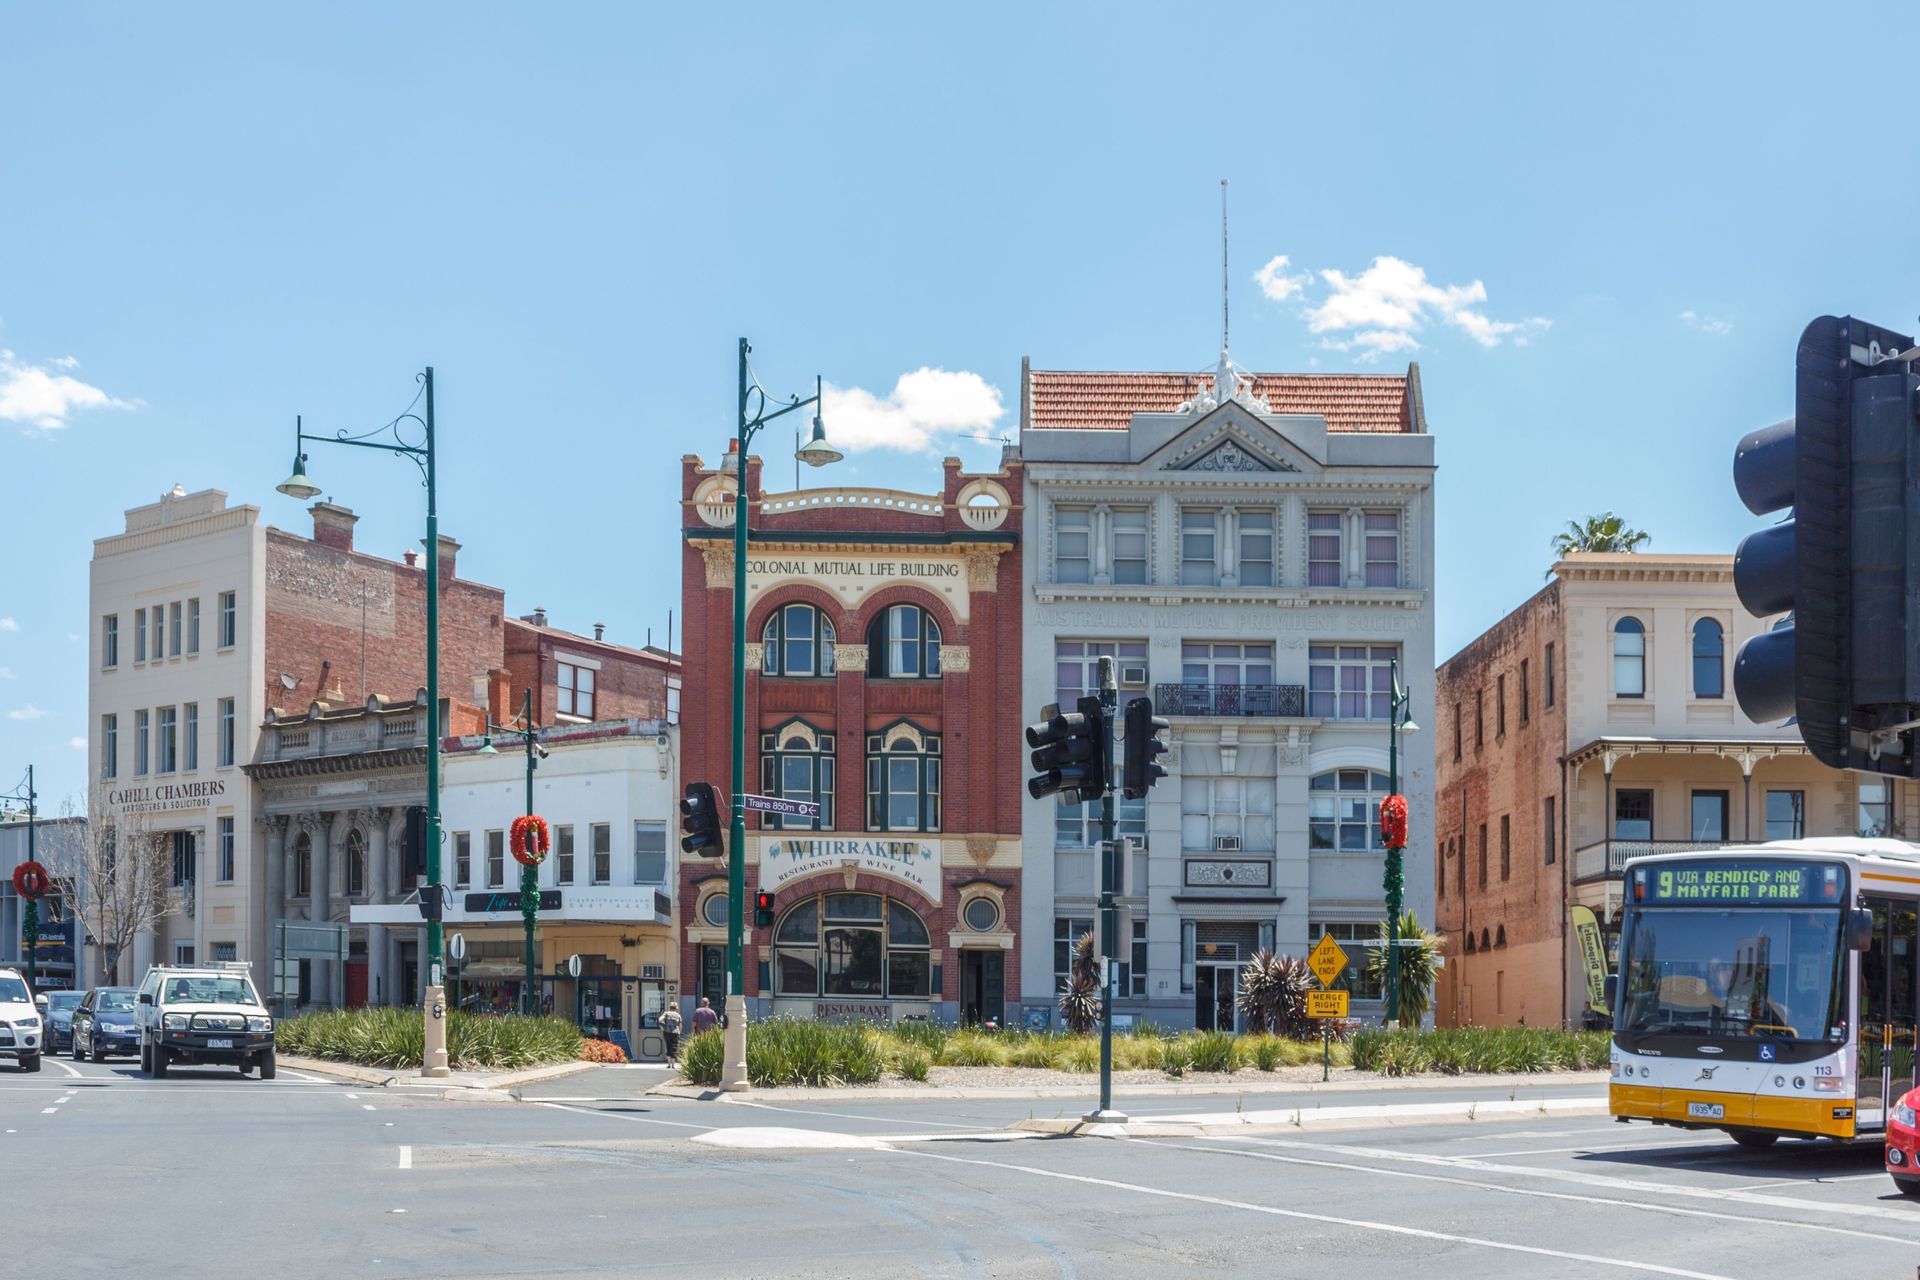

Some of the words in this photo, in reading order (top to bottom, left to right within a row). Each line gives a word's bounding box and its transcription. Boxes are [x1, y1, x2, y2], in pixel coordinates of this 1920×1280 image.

[746, 561, 808, 575] COLONIAL
[814, 562, 865, 576] MUTUAL
[870, 563, 896, 576] LIFE
[901, 564, 959, 577] BUILDING
[1033, 608, 1148, 628] AUSTRALIAN
[1154, 609, 1232, 630] MUTUAL
[1237, 612, 1338, 632] PROVIDENT
[1349, 613, 1424, 632] SOCIETY
[109, 787, 152, 805] CAHILL
[155, 780, 225, 800] CHAMBERS
[163, 802, 167, 810] &
[170, 798, 210, 809] SOLICITORS
[748, 798, 771, 809] Trains
[772, 801, 795, 812] 850m
[787, 840, 915, 866] WHIRRAKEE
[778, 859, 834, 882] RESTAURANT
[866, 859, 896, 872] WINE
[903, 870, 923, 885] BAR
[1676, 871, 1699, 884] VIA
[1705, 870, 1769, 884] BENDIGO
[1775, 870, 1800, 883] AND
[1659, 871, 1673, 898] 9
[1677, 885, 1750, 898] MAYFAIR
[1758, 885, 1800, 898] PARK
[1320, 947, 1335, 955] LEFT
[1318, 957, 1335, 965] LANE
[1318, 967, 1336, 975] ENDS
[817, 1003, 889, 1018] RESTAURANT
[1638, 1048, 1661, 1056] VOLVO
[1814, 1066, 1832, 1075] 113
